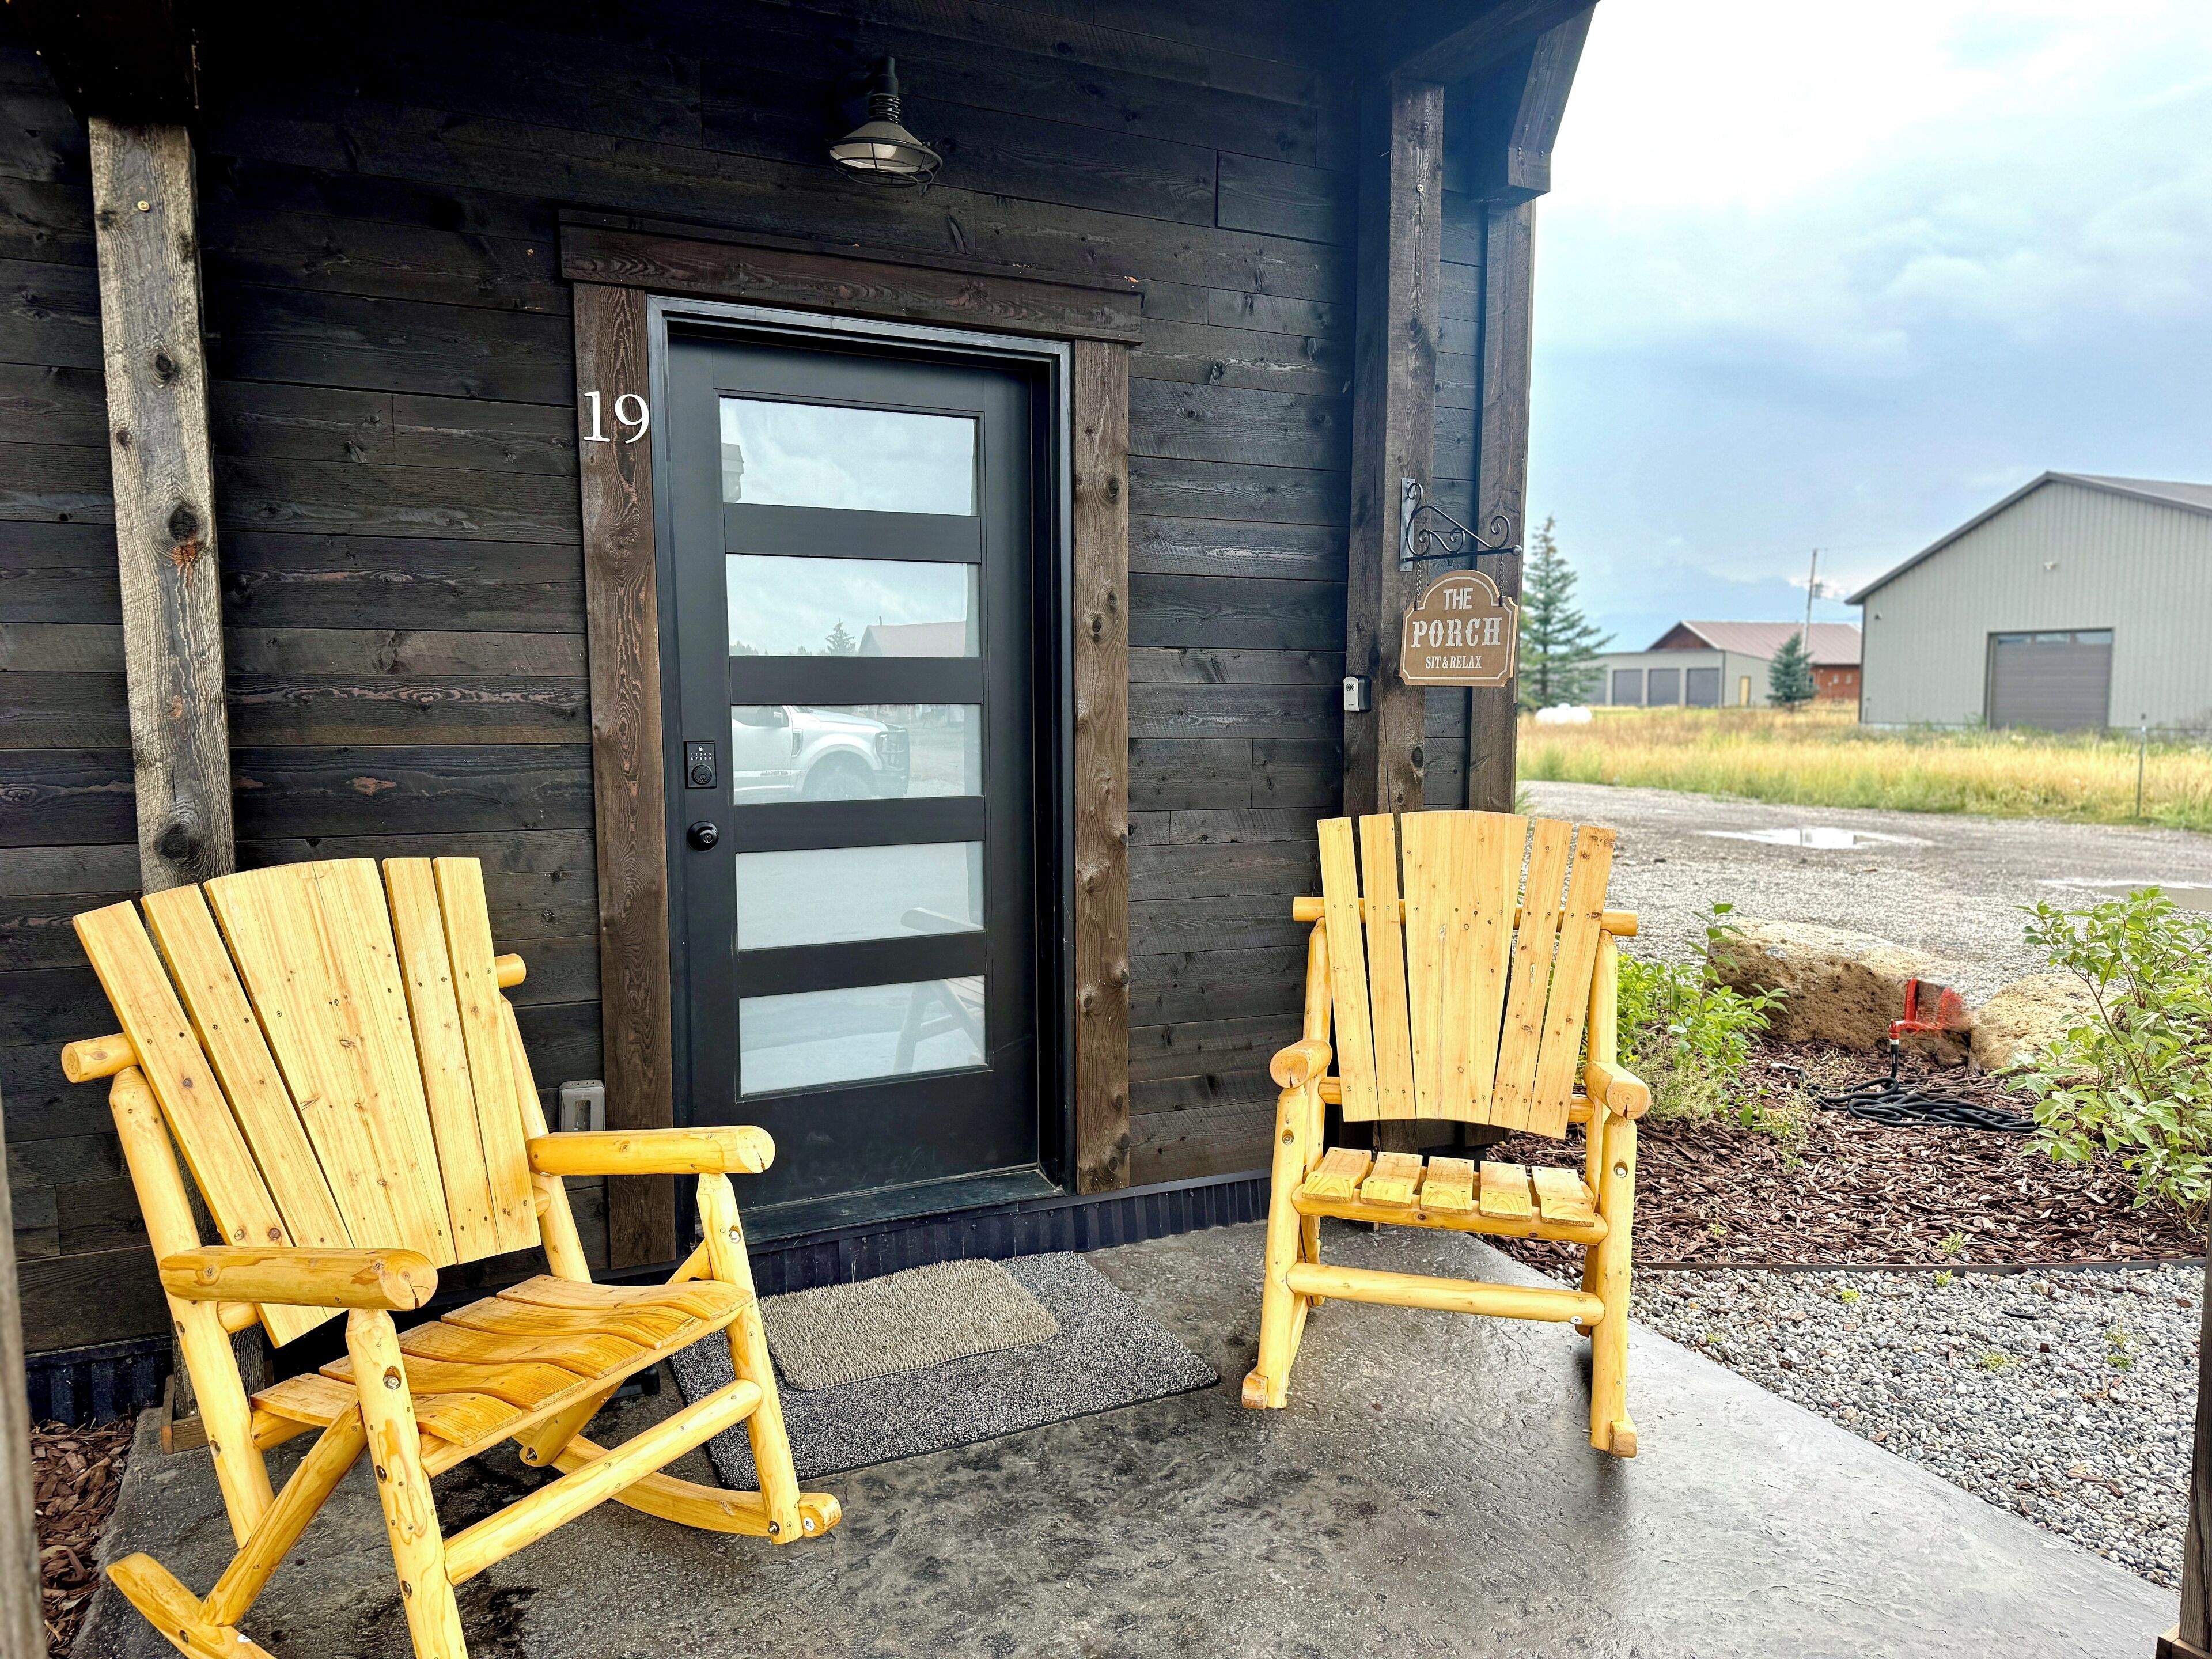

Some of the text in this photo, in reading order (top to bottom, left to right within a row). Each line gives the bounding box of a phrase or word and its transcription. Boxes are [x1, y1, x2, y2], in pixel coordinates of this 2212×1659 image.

[584, 391, 649, 444] 19
[1443, 588, 1474, 610] THE
[1411, 617, 1502, 647] PORCH
[1425, 656, 1441, 669] SIT
[1449, 655, 1482, 669] RELAX
